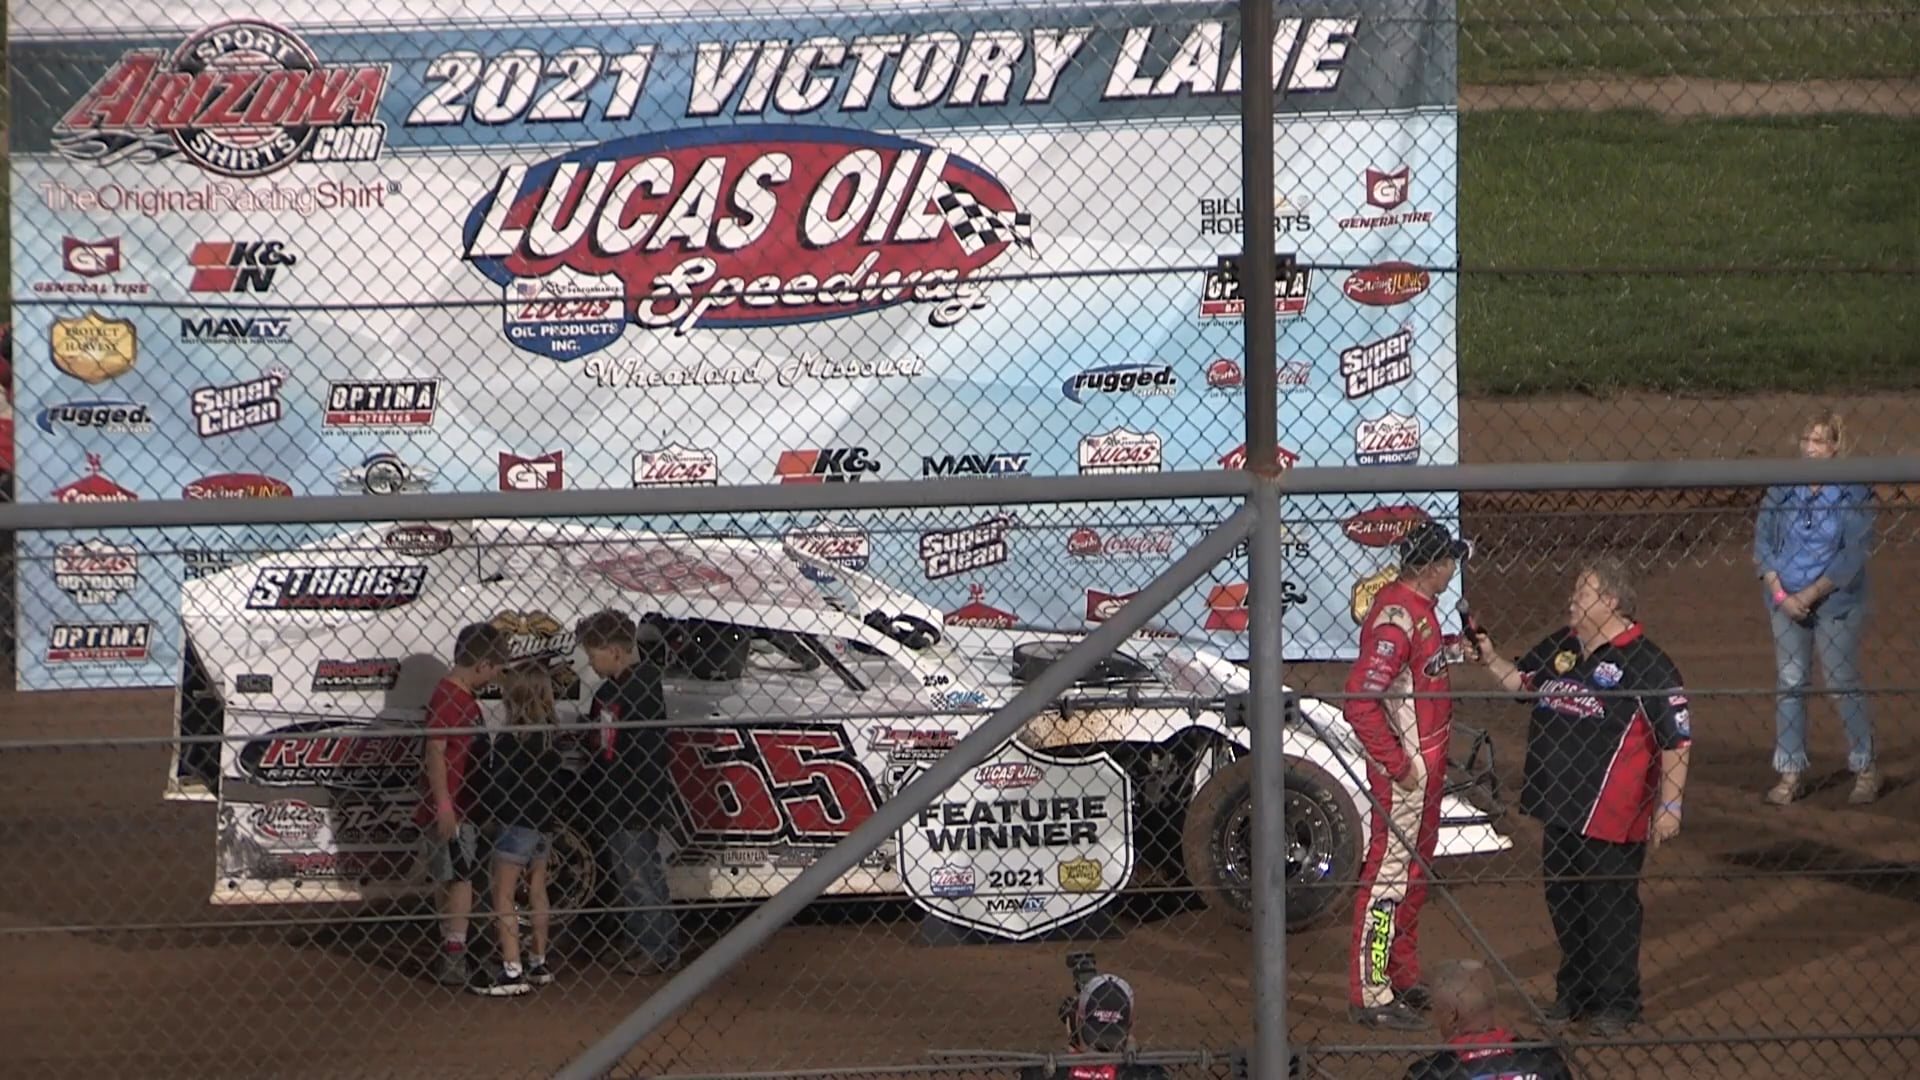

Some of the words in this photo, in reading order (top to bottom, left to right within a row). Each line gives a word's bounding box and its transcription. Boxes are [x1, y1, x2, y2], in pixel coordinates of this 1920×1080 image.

[195, 29, 294, 61] SPORT
[404, 43, 656, 126] 2021
[684, 26, 1095, 118] VICTORY
[190, 133, 297, 170] SHIRTS
[462, 151, 794, 262] LUCAS
[803, 146, 951, 249] OIL
[1338, 216, 1399, 229] GENERAL
[1402, 211, 1433, 224] TIRE
[33, 282, 107, 294] GENERAL
[113, 283, 149, 294] TIRE
[638, 251, 998, 337] Speedway
[517, 297, 612, 319] LUCAS
[180, 317, 292, 338] MAVTV
[511, 326, 536, 338] OIL
[541, 322, 619, 337] PRODUCTS
[551, 340, 581, 352] INC.
[1342, 332, 1412, 375] Super
[777, 350, 926, 387] Missouri
[1347, 355, 1412, 398] Clean
[193, 377, 281, 414] Super
[331, 385, 432, 410] OPTIMA
[200, 400, 278, 436] Clean
[1365, 430, 1419, 451] LUCAS
[922, 452, 1031, 477] MAVTV
[1088, 446, 1158, 464] LUCAS
[643, 462, 712, 480] LUCAS
[922, 517, 1009, 559] Super
[927, 541, 1005, 578] Clean
[52, 626, 147, 648] OPTIMA
[975, 765, 1017, 781] LUCAS
[917, 795, 1108, 828] FEATURE
[925, 821, 1099, 851] WINNER
[988, 868, 1045, 888] 2021
